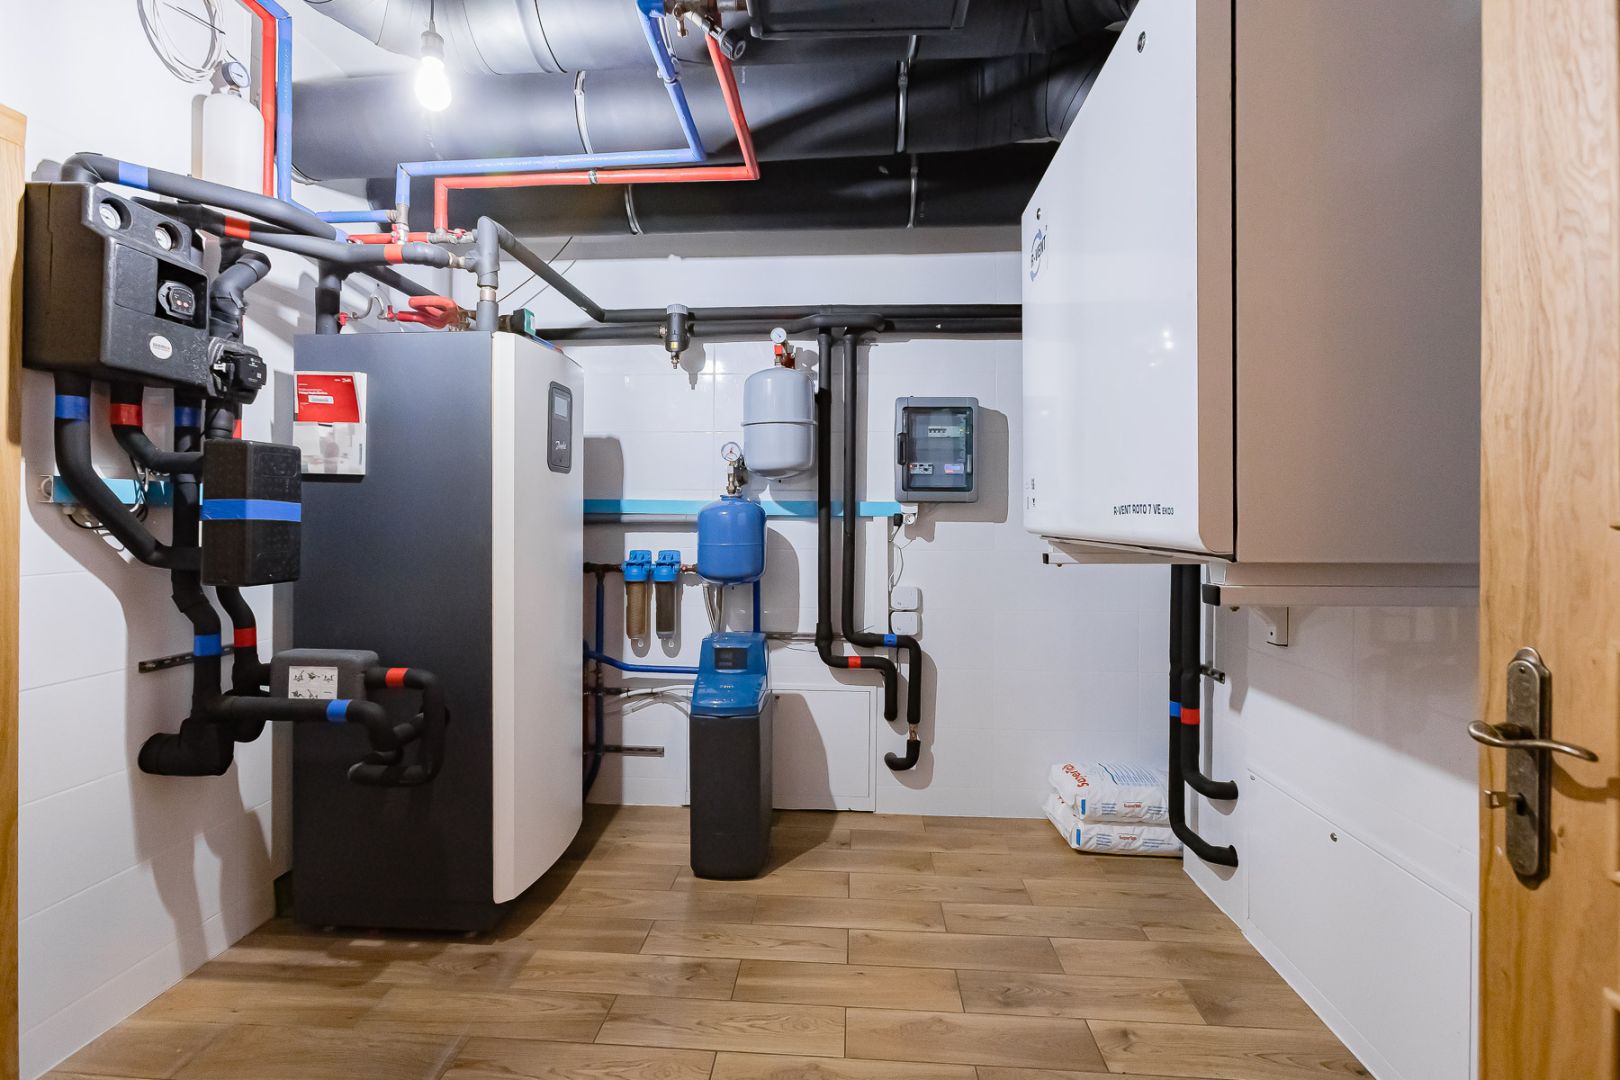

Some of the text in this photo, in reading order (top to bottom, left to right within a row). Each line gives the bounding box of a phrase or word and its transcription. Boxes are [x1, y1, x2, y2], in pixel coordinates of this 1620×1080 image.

[1113, 504, 1131, 515] R-VENT
[1131, 503, 1147, 514] ROTO
[1147, 503, 1152, 514] 7
[1152, 503, 1161, 514] VE
